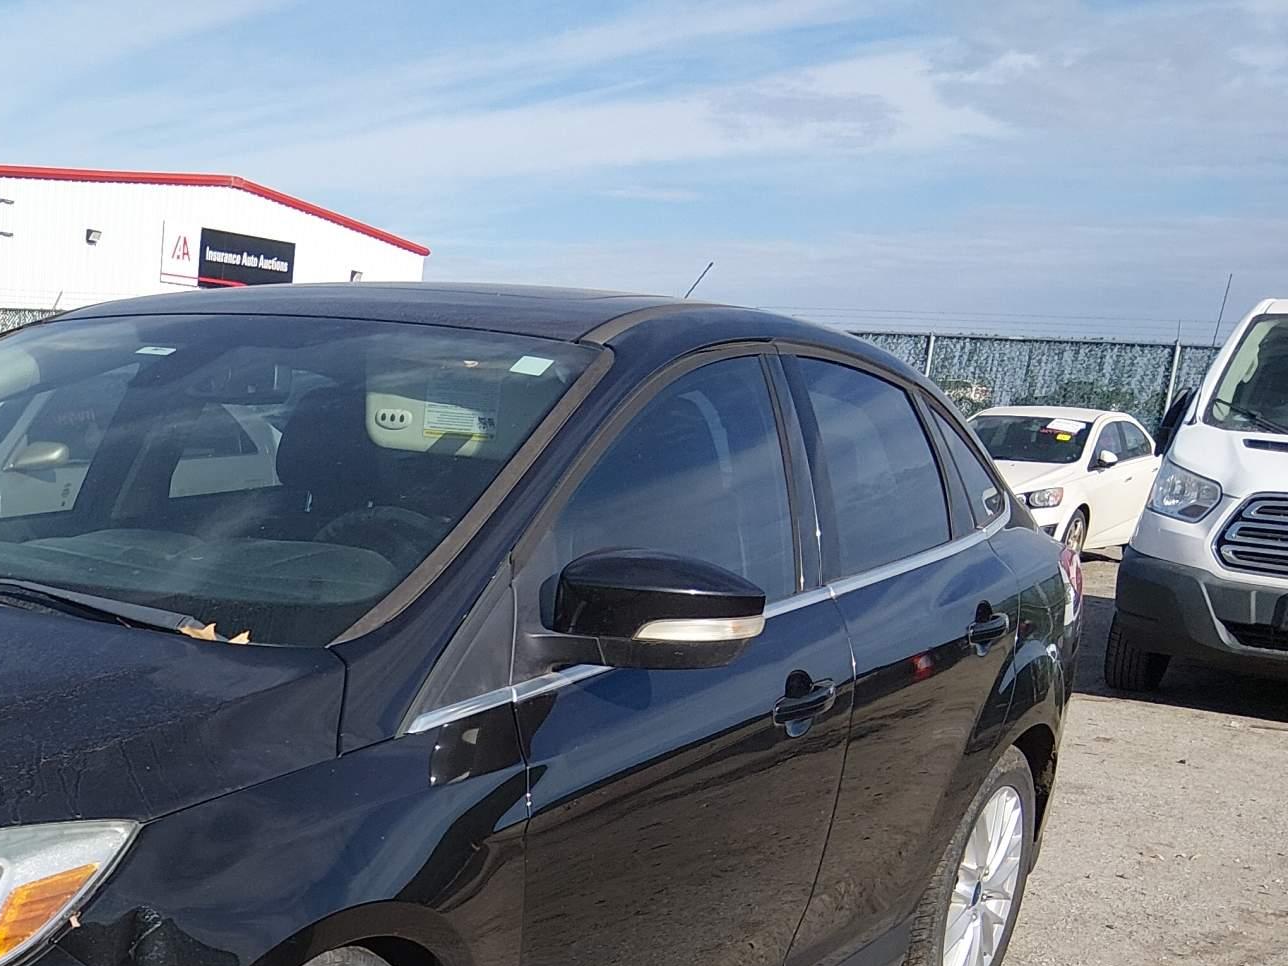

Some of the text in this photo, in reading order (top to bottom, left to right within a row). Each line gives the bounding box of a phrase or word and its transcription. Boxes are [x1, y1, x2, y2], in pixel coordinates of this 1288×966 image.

[206, 246, 289, 272] Insurance Auto Auctions
